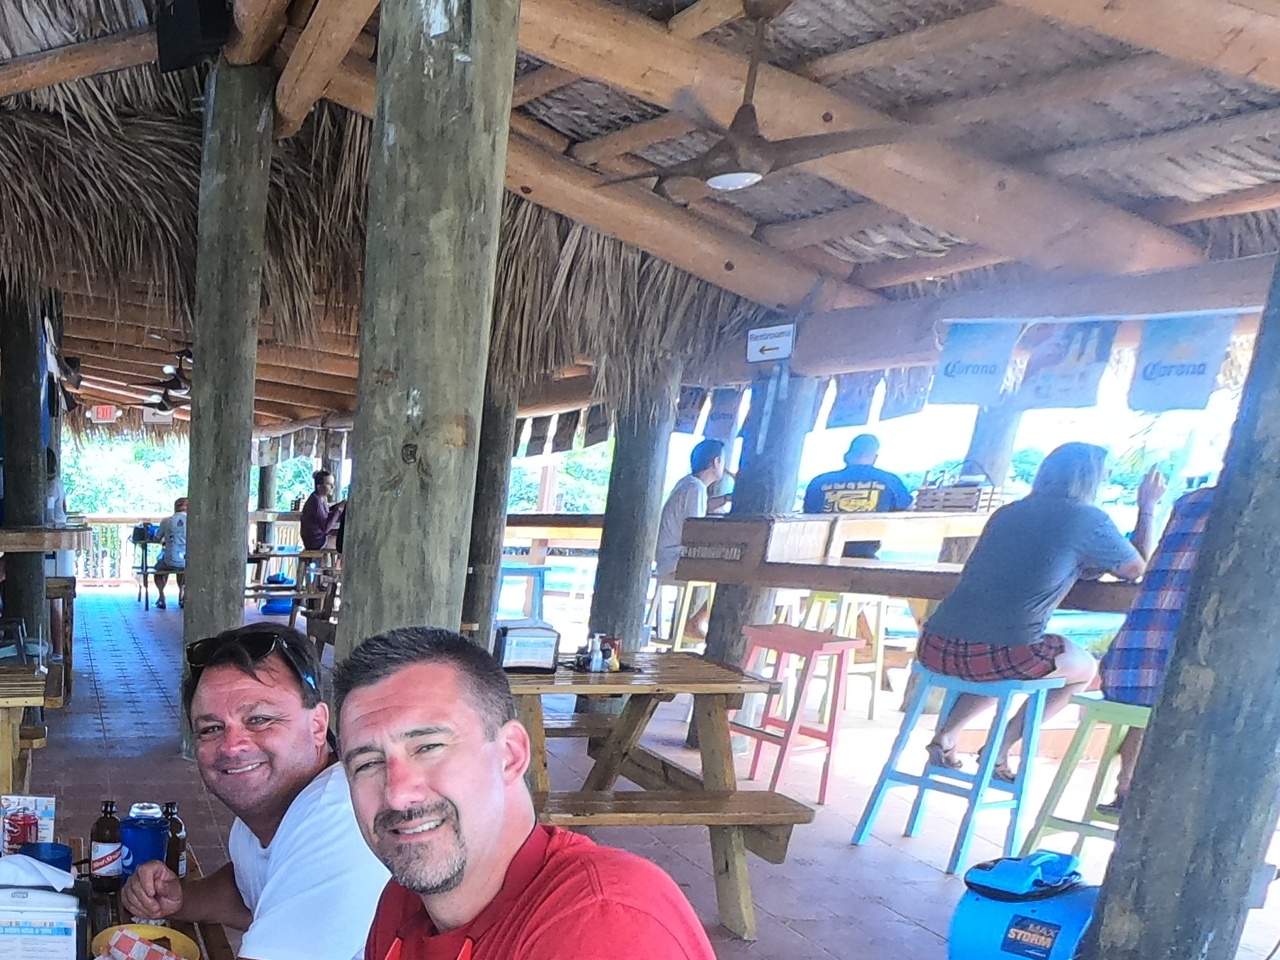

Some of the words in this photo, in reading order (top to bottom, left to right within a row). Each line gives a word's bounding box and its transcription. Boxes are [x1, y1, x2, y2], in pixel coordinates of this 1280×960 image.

[943, 359, 997, 378] Corona
[1142, 360, 1207, 381] Corona
[96, 406, 112, 420] EXIT
[1008, 928, 1053, 948] STORM
[1028, 923, 1058, 937] MAX
